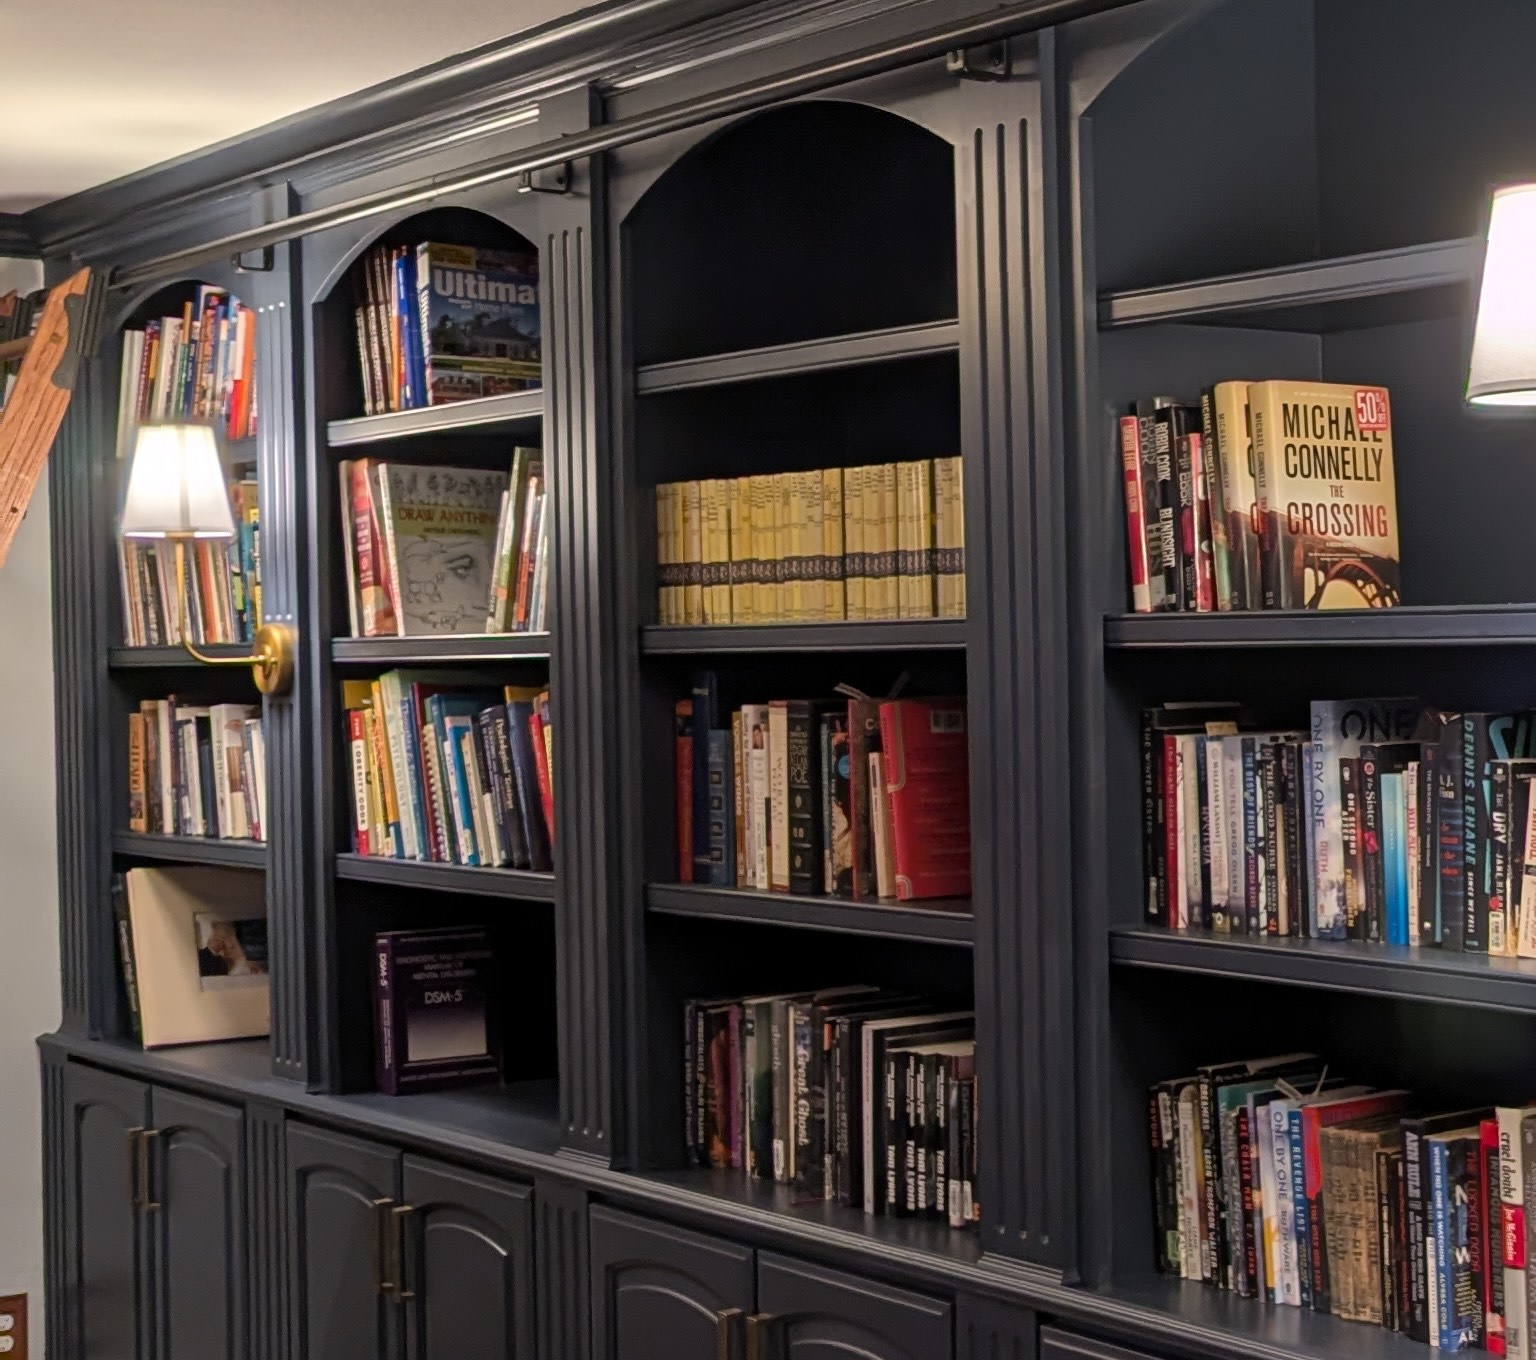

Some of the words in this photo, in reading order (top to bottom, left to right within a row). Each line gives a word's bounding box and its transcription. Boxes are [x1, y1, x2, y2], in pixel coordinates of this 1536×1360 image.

[1202, 395, 1211, 435] MICHAEL
[1255, 412, 1264, 447] MICHAEL
[1140, 417, 1149, 465] COOK
[1156, 422, 1169, 451] ROBIN
[1284, 443, 1383, 482] CONNELLY
[1330, 485, 1344, 498] THE
[398, 508, 432, 522] DRAW
[1286, 502, 1388, 537] CROSSING
[1160, 508, 1176, 568] BLINDSIGHT
[1464, 720, 1474, 788] DENNIS
[1266, 762, 1275, 787] THE
[1315, 762, 1323, 782] BY
[1267, 791, 1276, 828] GOOD
[1315, 789, 1325, 827] ONE
[1366, 791, 1377, 828] Sister
[1465, 795, 1476, 865] LEHANE
[1493, 811, 1506, 843] DRY
[1268, 833, 1276, 869] NURSE
[1496, 853, 1504, 878] JANE
[379, 953, 387, 986] DSM-5
[425, 990, 463, 1004] DSM-5
[1274, 1112, 1284, 1142] ONE
[918, 1148, 926, 1172] Tom
[1276, 1148, 1285, 1166] BY
[1406, 1131, 1420, 1159] ANN
[1501, 1132, 1512, 1161] cruel
[918, 1175, 926, 1209] Lyons
[1278, 1169, 1288, 1198] ONE
[1407, 1161, 1421, 1196] RULE
[1501, 1165, 1516, 1199] doubt
[1283, 1242, 1292, 1274] WARE
